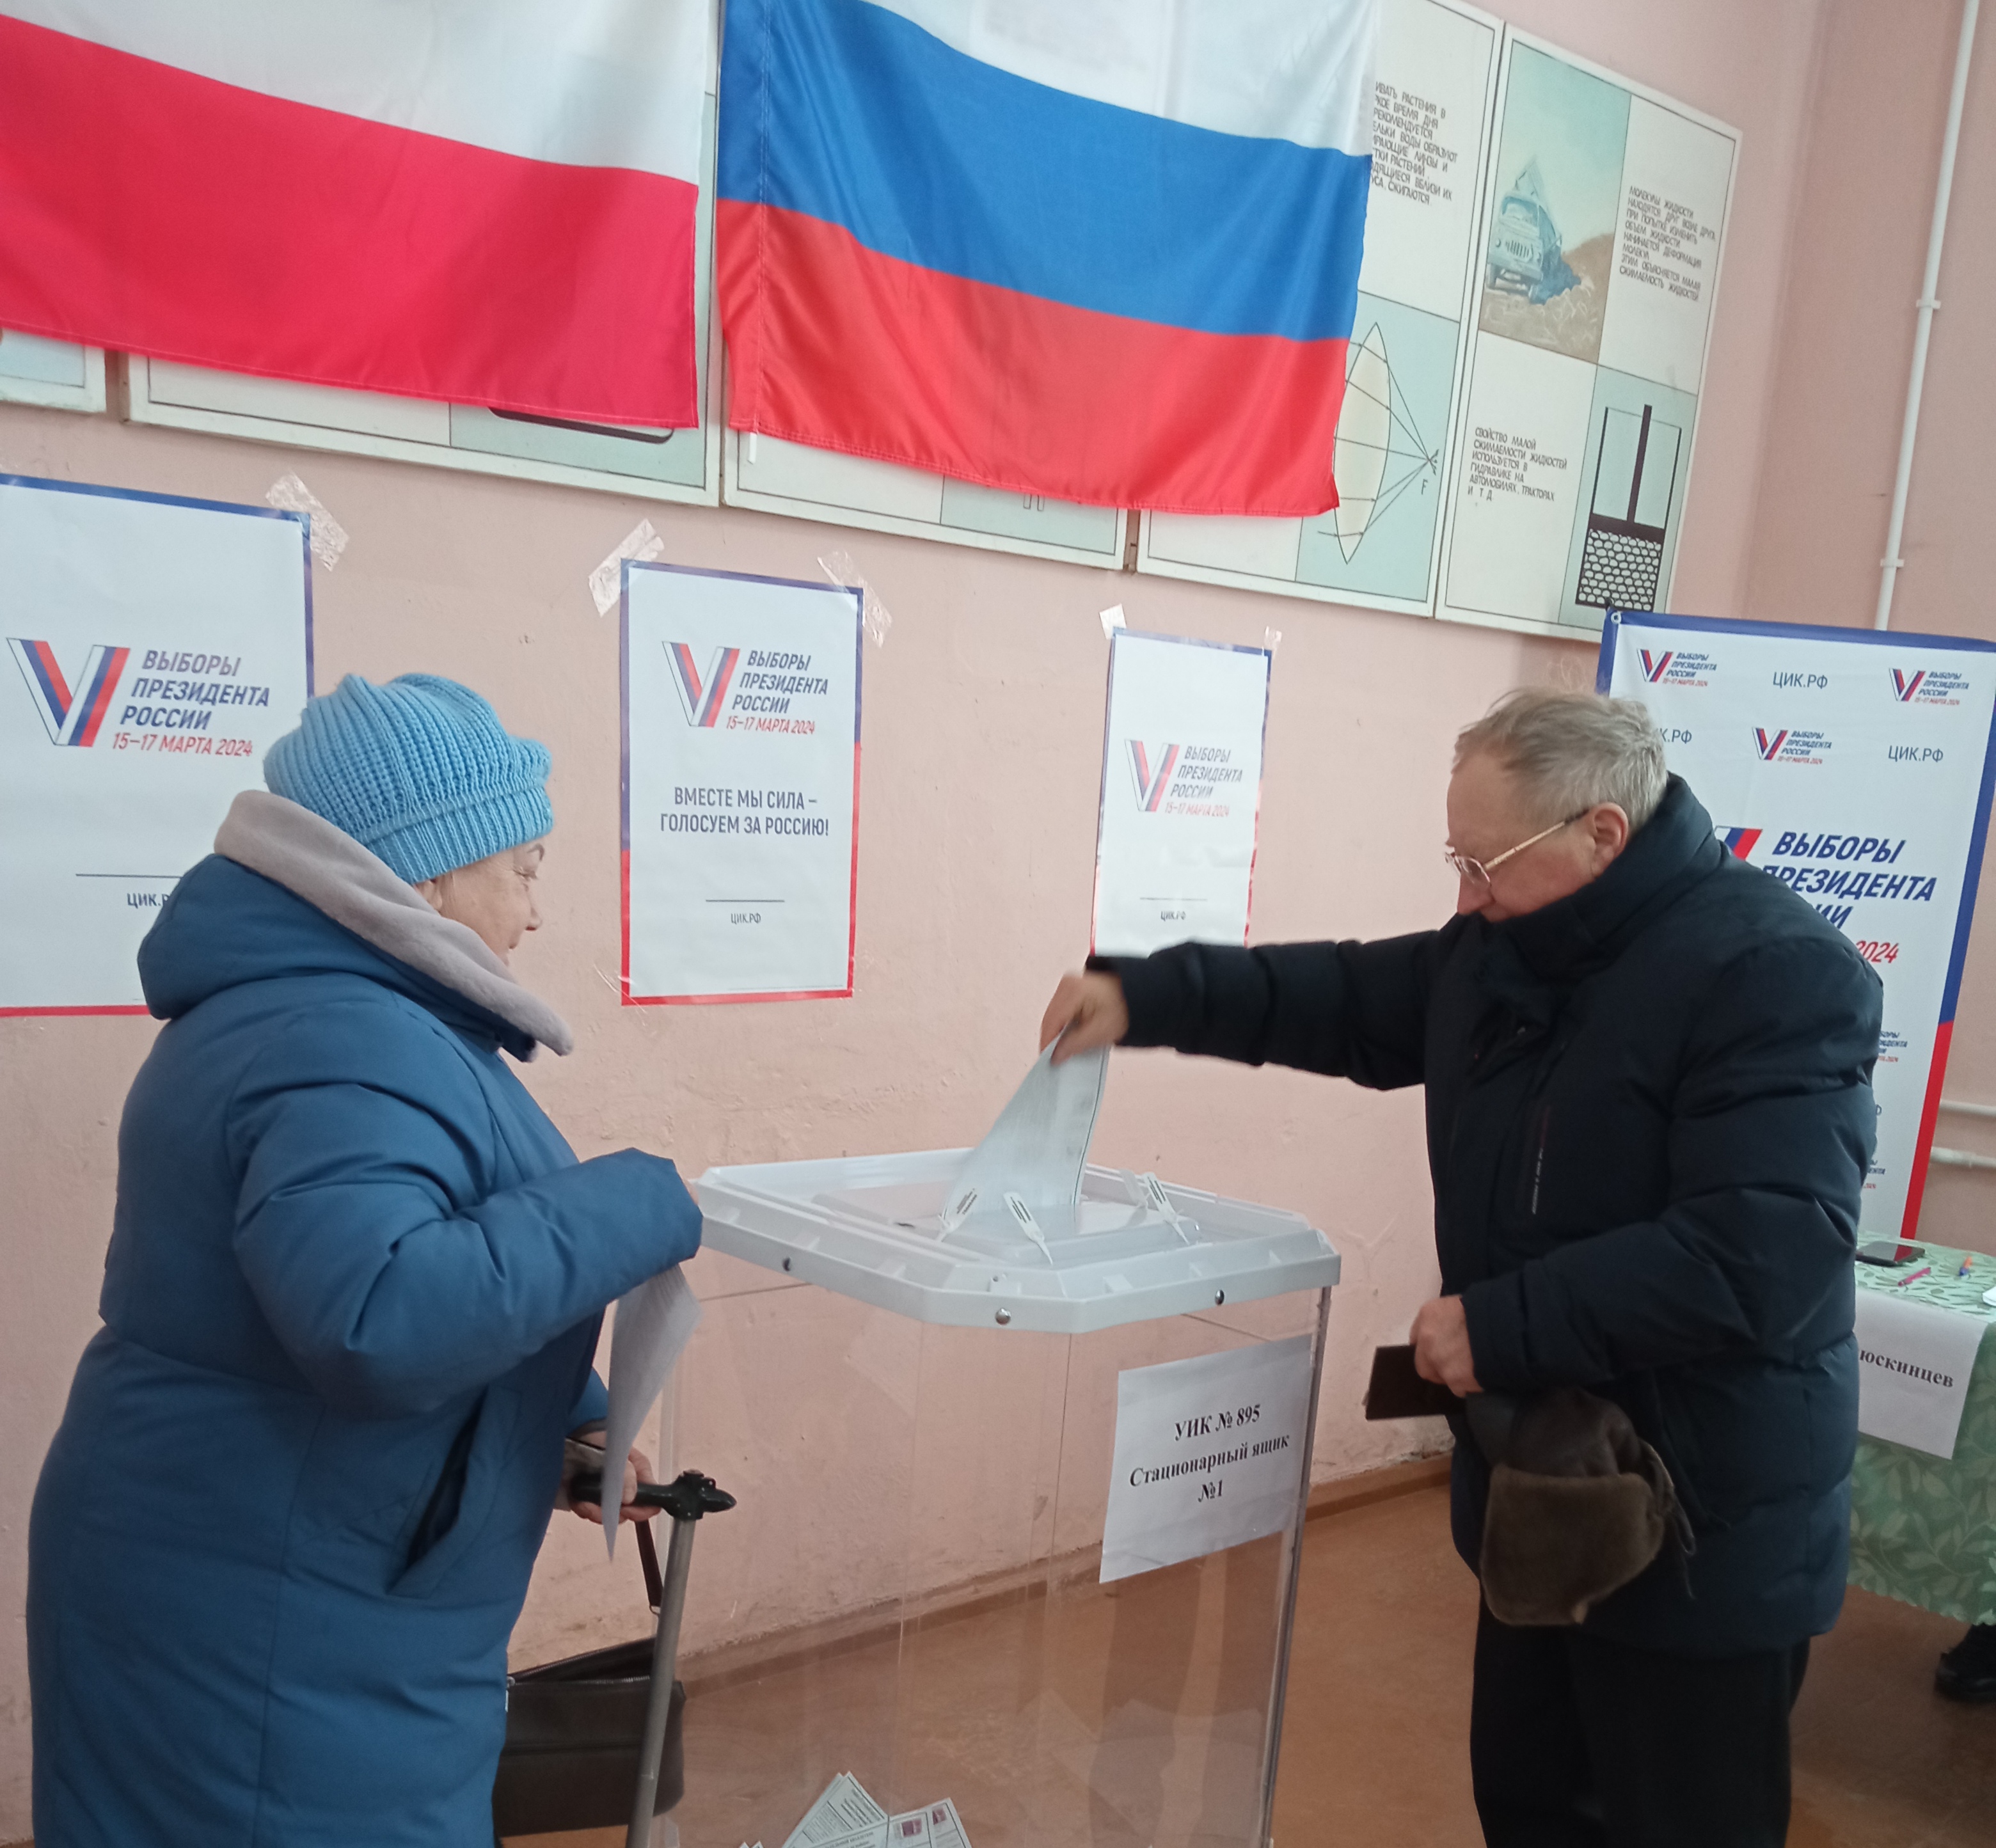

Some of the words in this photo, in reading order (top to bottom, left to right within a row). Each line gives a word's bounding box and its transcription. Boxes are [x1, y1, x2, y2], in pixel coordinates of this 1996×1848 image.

[1375, 81, 1397, 99] ИВАТЬ
[1402, 91, 1437, 116] РАСТЕНИЯ
[1441, 107, 1446, 120] В
[1393, 102, 1419, 122] ВРЕМЯ
[1423, 114, 1439, 130] ДНЯ
[1373, 121, 1396, 139] ЕЛЬКИ
[1400, 131, 1422, 150] ВОДЫ
[1423, 141, 1458, 164] ОБРАЗУЮТ
[1373, 147, 1389, 164] ТКИ
[1442, 162, 1448, 173] И
[1443, 188, 1452, 201] ИХ
[1626, 207, 1639, 221] ПРИ
[1475, 426, 1508, 443] СВОЙСТВО
[1511, 436, 1537, 451] МАЛОЙ
[1472, 450, 1520, 470] ИСПОЛЬЗУЕТСЯ
[1523, 461, 1528, 472] В
[1473, 439, 1526, 460] СЖИМАЕМОСТИ
[1529, 452, 1568, 470] ЖИДКОСТЕЙ
[1470, 461, 1512, 480] ГИДРАВЛИКЕ
[1514, 472, 1525, 484] НА
[1467, 485, 1474, 496] И
[1521, 484, 1555, 501] ТРАКТОРАХ
[141, 649, 242, 677] ВЫБОРЫ
[747, 649, 812, 672] ВЫБОРЫ
[1671, 661, 1717, 671] ПРЕЗИДЕНТА
[1676, 651, 1709, 661] ВЫБОРЫ
[739, 672, 829, 695] ПРЕЗИДЕНТА
[1772, 671, 1828, 690] ЦИК.РФ
[1923, 679, 1970, 690] ПРЕЗИДЕНТА
[1928, 671, 1962, 680] ВЫБОРЫ
[131, 677, 271, 707] ПРЕЗИДЕНТА
[731, 694, 791, 714] РОССИИ
[119, 704, 212, 731] РОССИИ
[755, 716, 790, 733] МАРТА
[790, 719, 816, 735] 2024
[1659, 727, 1692, 744] К.РФ
[1786, 739, 1832, 749] ПРЕЗИДЕНТА
[1791, 730, 1825, 739] ВЫБОРЫ
[159, 734, 212, 754] МАРТА
[215, 738, 254, 757] 2024
[1184, 745, 1232, 763] ВЫБОРЫ
[1887, 745, 1944, 762] ЦИК.РФ
[1177, 764, 1244, 784] ПРЕЗИДЕНТА
[674, 786, 733, 807] ВМЕСТЕ
[737, 789, 763, 809] МЫ
[767, 791, 805, 810] СИЛА
[1169, 784, 1214, 799] РОССИИ
[1185, 803, 1211, 816] МАРТА
[1211, 805, 1230, 817] 2024
[660, 812, 740, 833] ГОЛОСУЕМ
[743, 816, 761, 835] ЗА
[765, 816, 829, 837] РОССИЮ!
[1771, 831, 1907, 864] ВЫБОРЫ
[127, 892, 170, 909] ЦИК.Р
[730, 912, 762, 925] ЦИК.РФ
[1855, 940, 1900, 964] 2024
[1860, 1349, 1954, 1388] юскинцев
[1173, 1415, 1213, 1442] УИК
[1215, 1410, 1233, 1432] №
[1236, 1403, 1262, 1426] 895
[1129, 1441, 1249, 1487] Стационарный
[1252, 1434, 1290, 1458] ящик
[1198, 1479, 1224, 1503] №1
